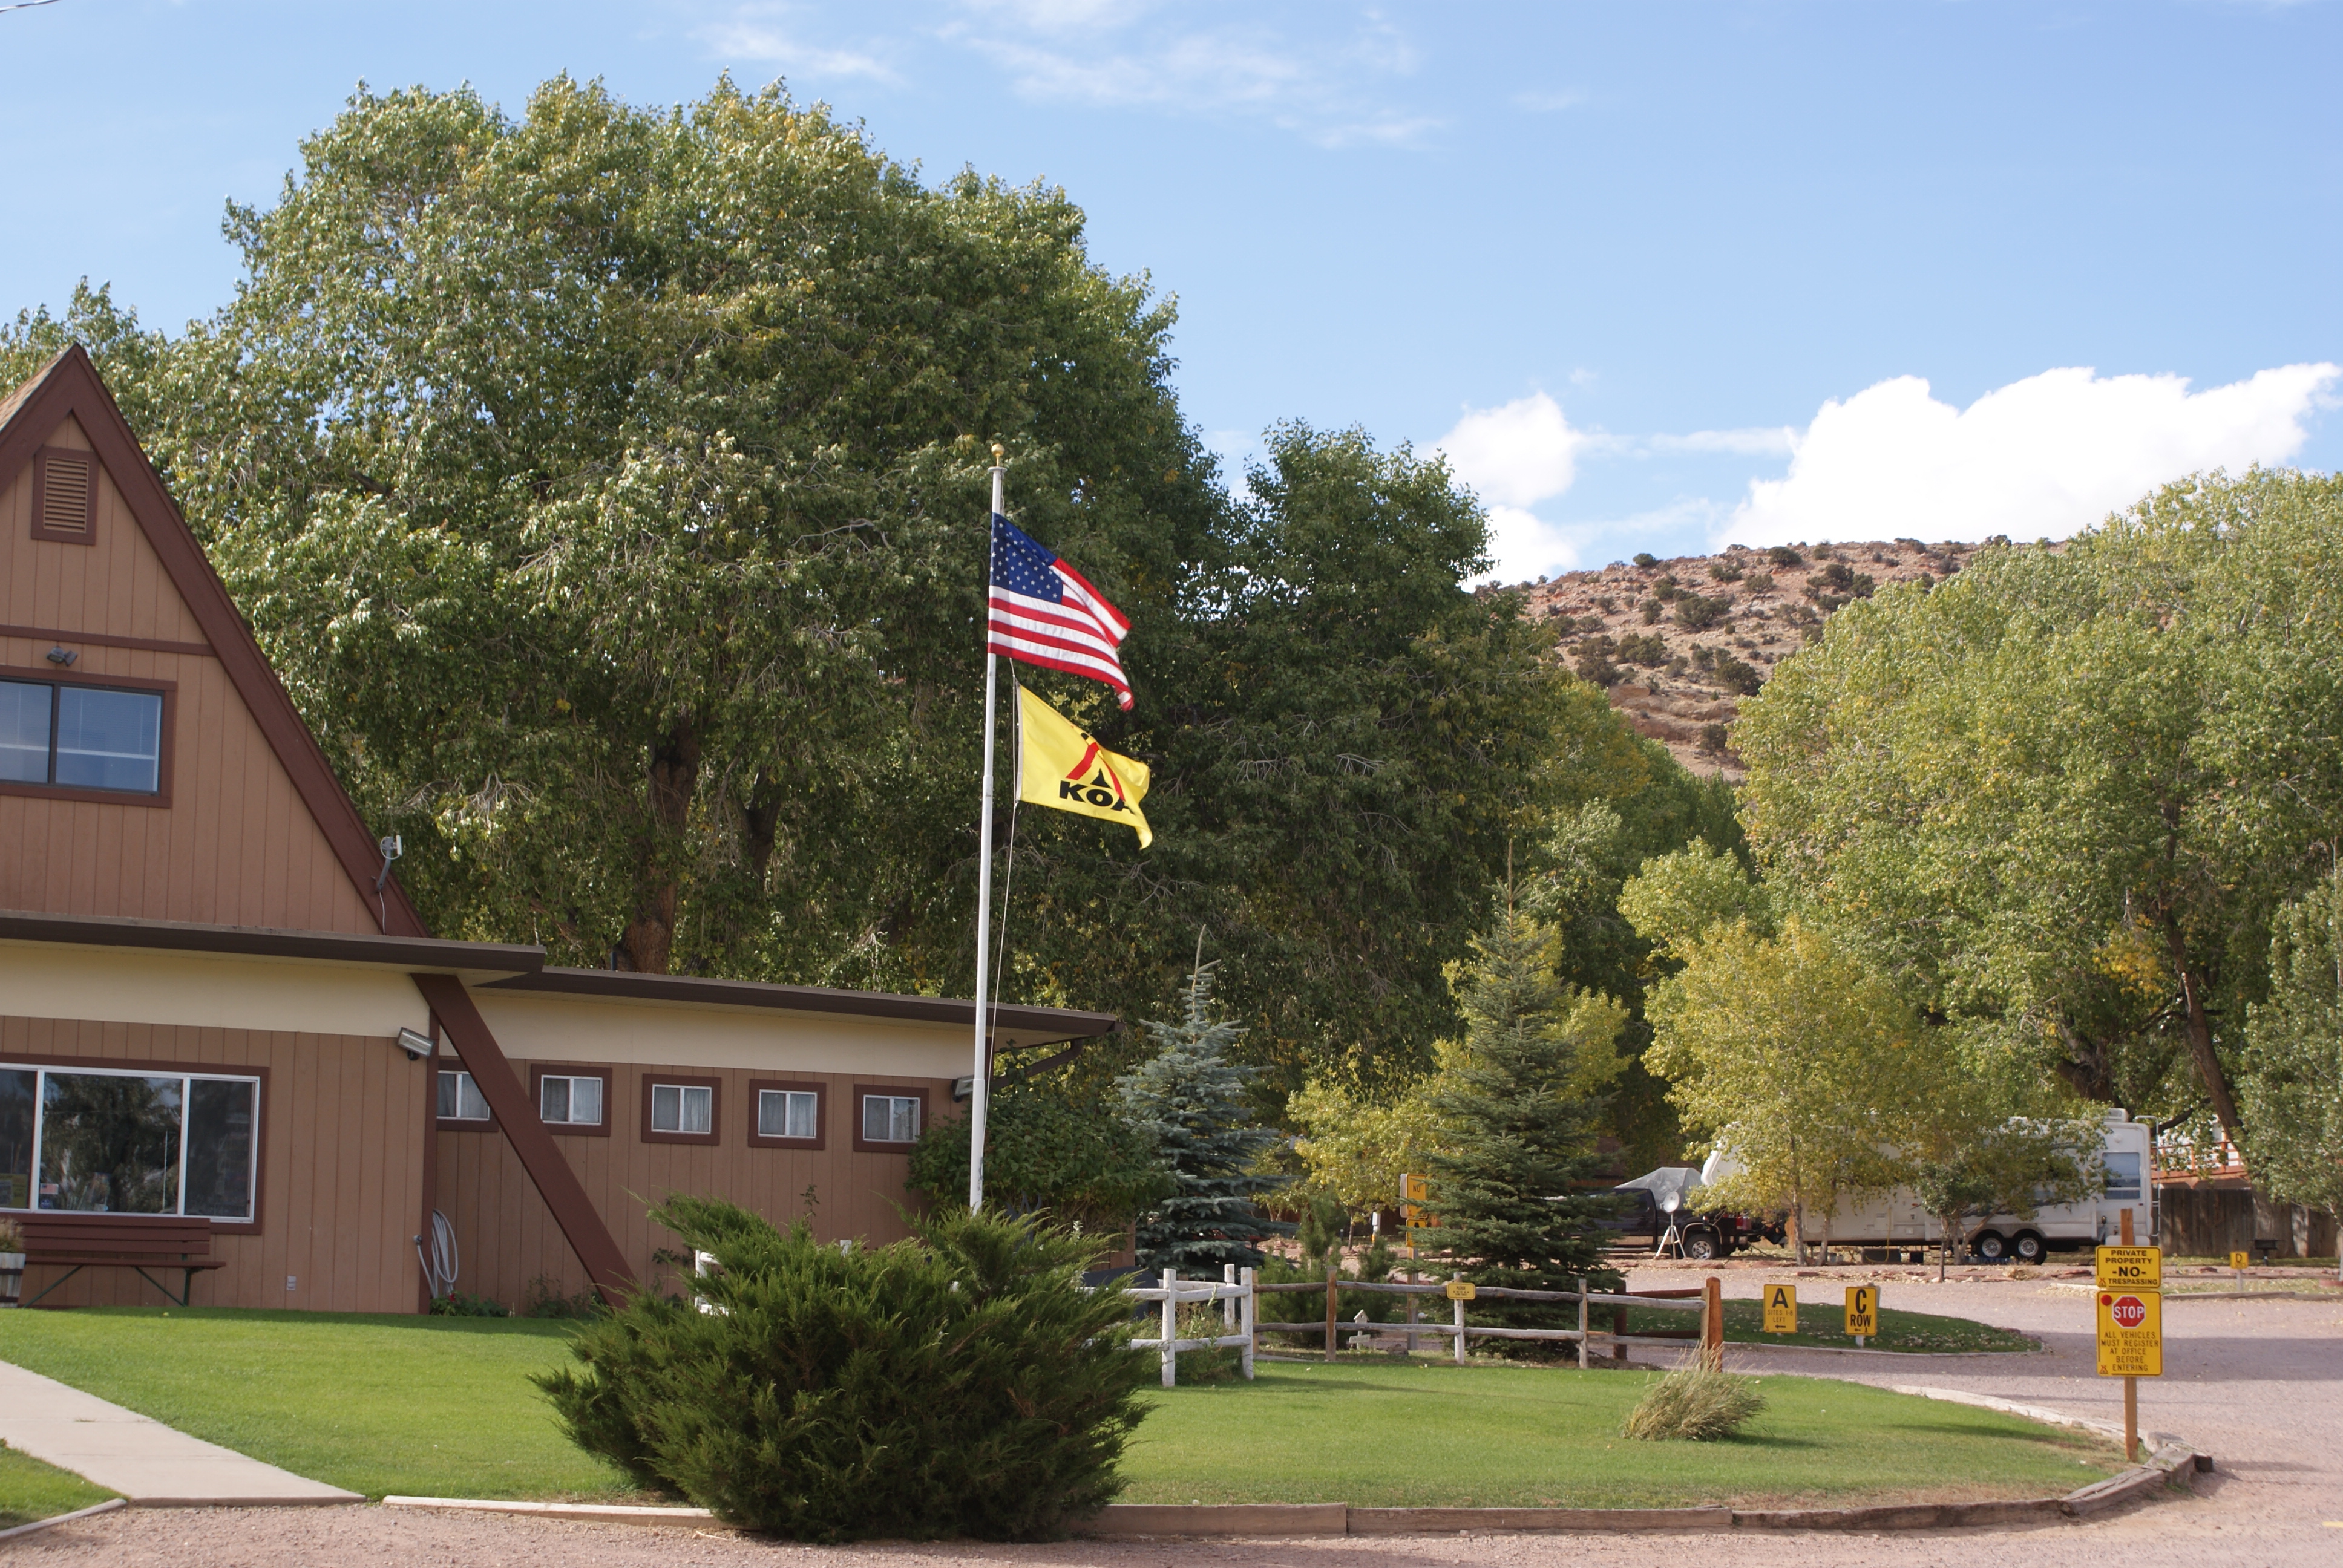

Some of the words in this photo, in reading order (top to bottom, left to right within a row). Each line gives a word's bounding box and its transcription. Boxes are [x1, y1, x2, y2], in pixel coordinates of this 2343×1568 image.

[1059, 780, 1136, 815] KOA
[1772, 1288, 1789, 1308] A
[1855, 1289, 1867, 1314] C
[1850, 1314, 1872, 1327] ROW
[2114, 1306, 2145, 1319] STOP
